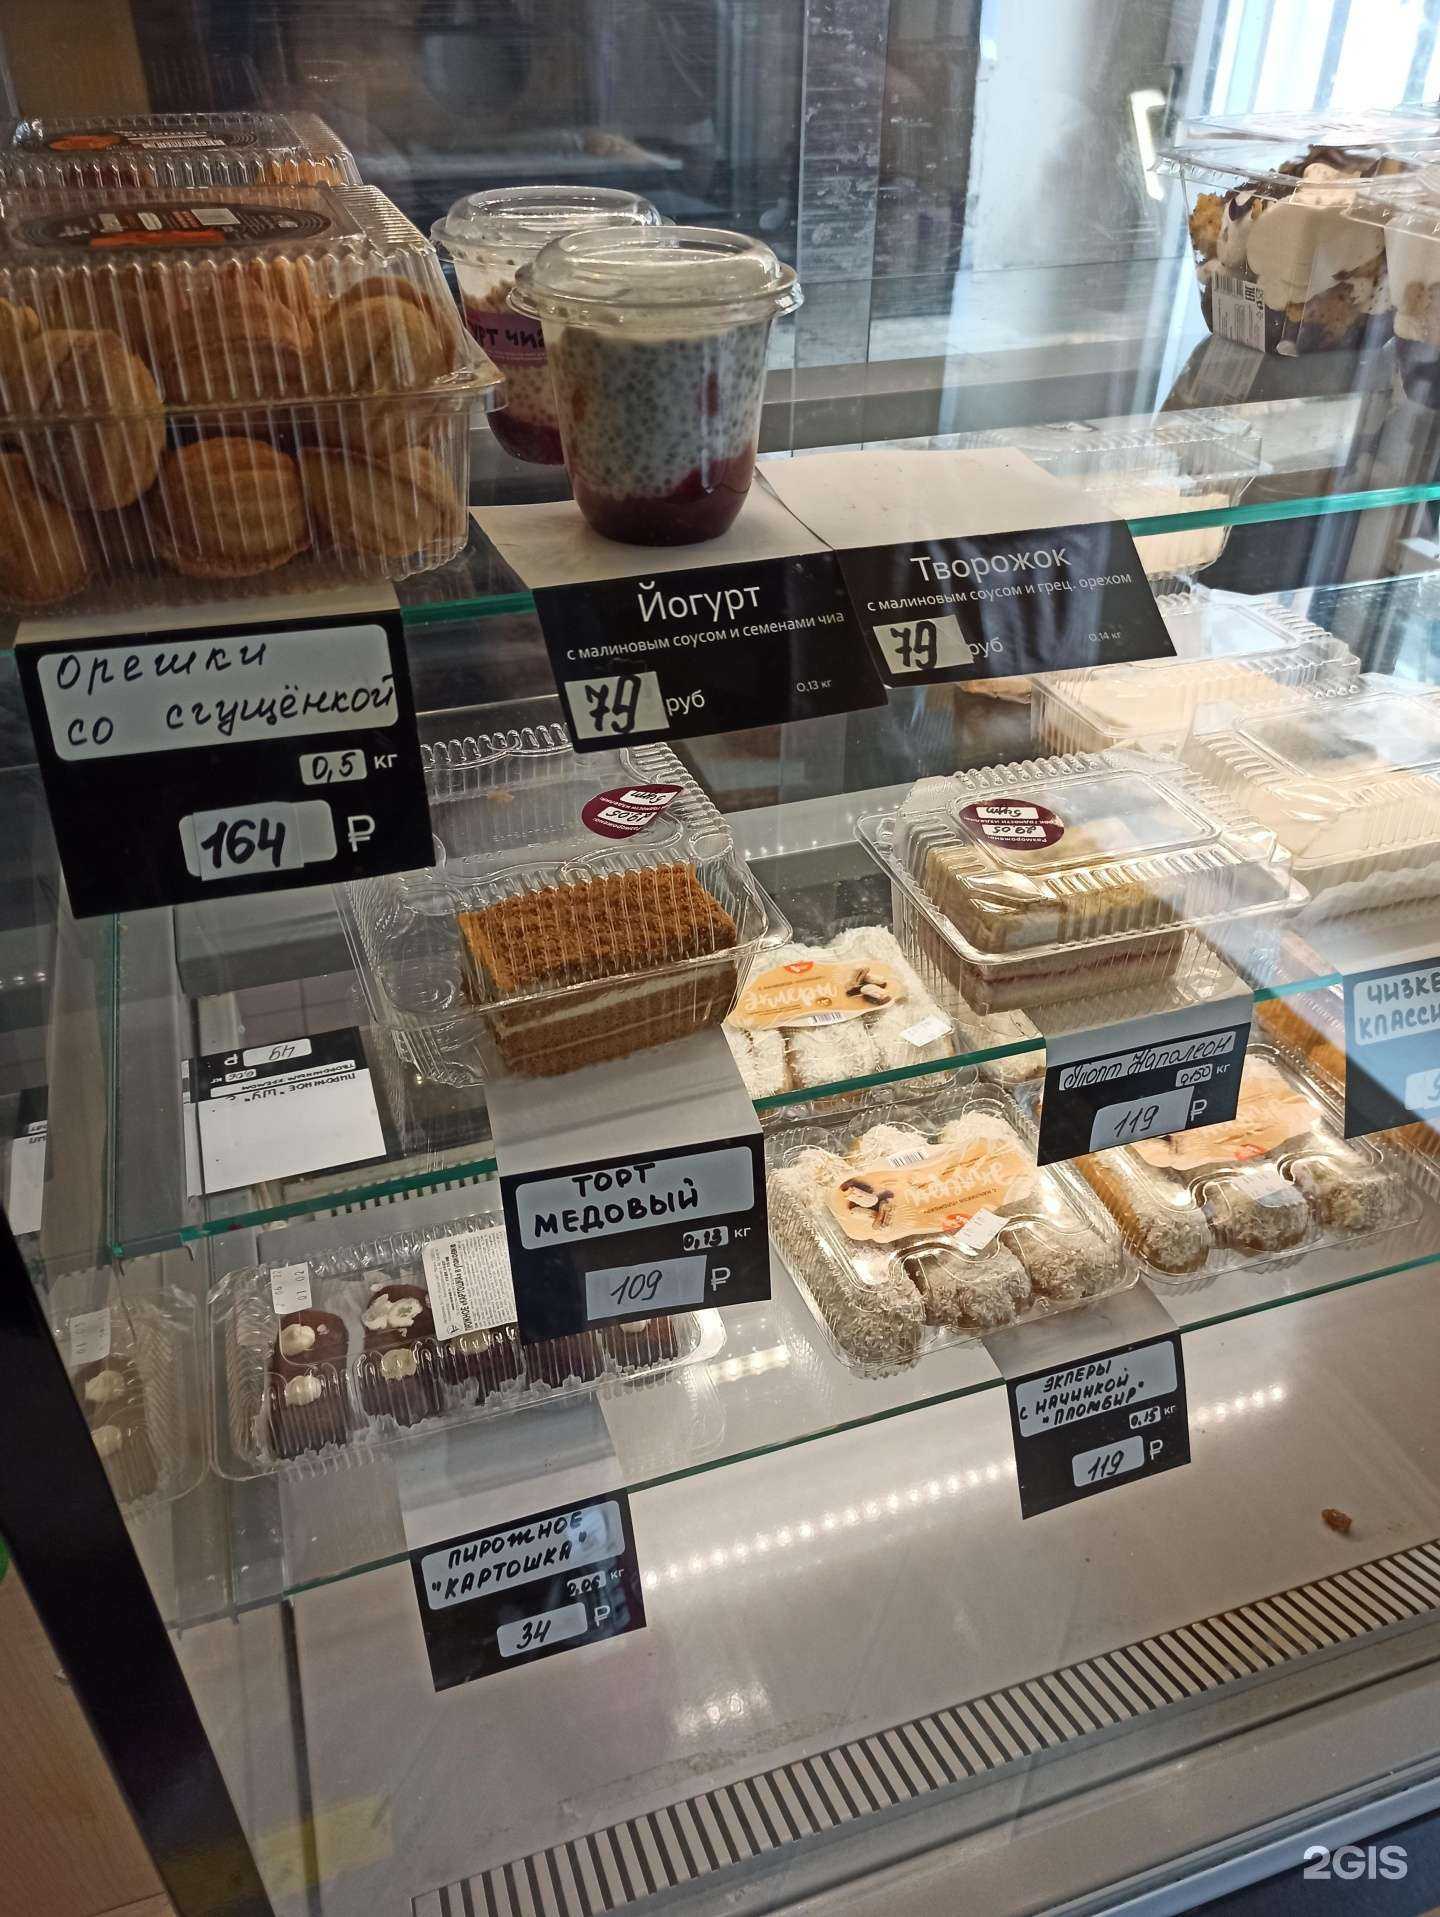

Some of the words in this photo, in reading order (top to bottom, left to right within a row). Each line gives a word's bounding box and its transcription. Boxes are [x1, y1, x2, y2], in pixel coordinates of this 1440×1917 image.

[910, 548, 1071, 583] Творожок
[638, 581, 761, 622] Йогурт
[867, 601, 876, 612] с
[878, 589, 967, 611] малиновым
[970, 582, 1022, 603] соусом
[1025, 583, 1035, 594] и
[1037, 578, 1076, 597] грец.
[1079, 571, 1132, 590] орехом
[567, 649, 576, 660] с
[578, 636, 670, 660] малиновым
[673, 628, 727, 648] соусом
[730, 626, 740, 638] и
[743, 616, 815, 637] семенами
[819, 611, 844, 627] чиа
[890, 619, 938, 670] 79
[56, 642, 267, 696] Орешки
[821, 678, 832, 689] кг
[67, 716, 114, 746] со
[166, 672, 393, 735] сгущёнкой
[585, 673, 641, 734] 79
[666, 690, 705, 716] руб
[312, 754, 354, 783] 0,5
[374, 755, 397, 771] кг
[201, 819, 286, 868] 164
[269, 1045, 295, 1060] 49
[1216, 1063, 1230, 1074] кг
[1114, 1105, 1159, 1138] 119
[572, 1162, 655, 1197] ТОРТ
[534, 1178, 698, 1237] МЕДОВЫЙ
[734, 1228, 751, 1238] кг
[610, 1270, 663, 1304] 109
[1036, 1368, 1129, 1414] НАЧИНКОЙ
[1165, 1405, 1176, 1415] кг
[1088, 1450, 1124, 1480] 119
[448, 1511, 582, 1569] ПИРОЖНОЕ
[611, 1567, 624, 1580] кг
[517, 1620, 551, 1649] 34
